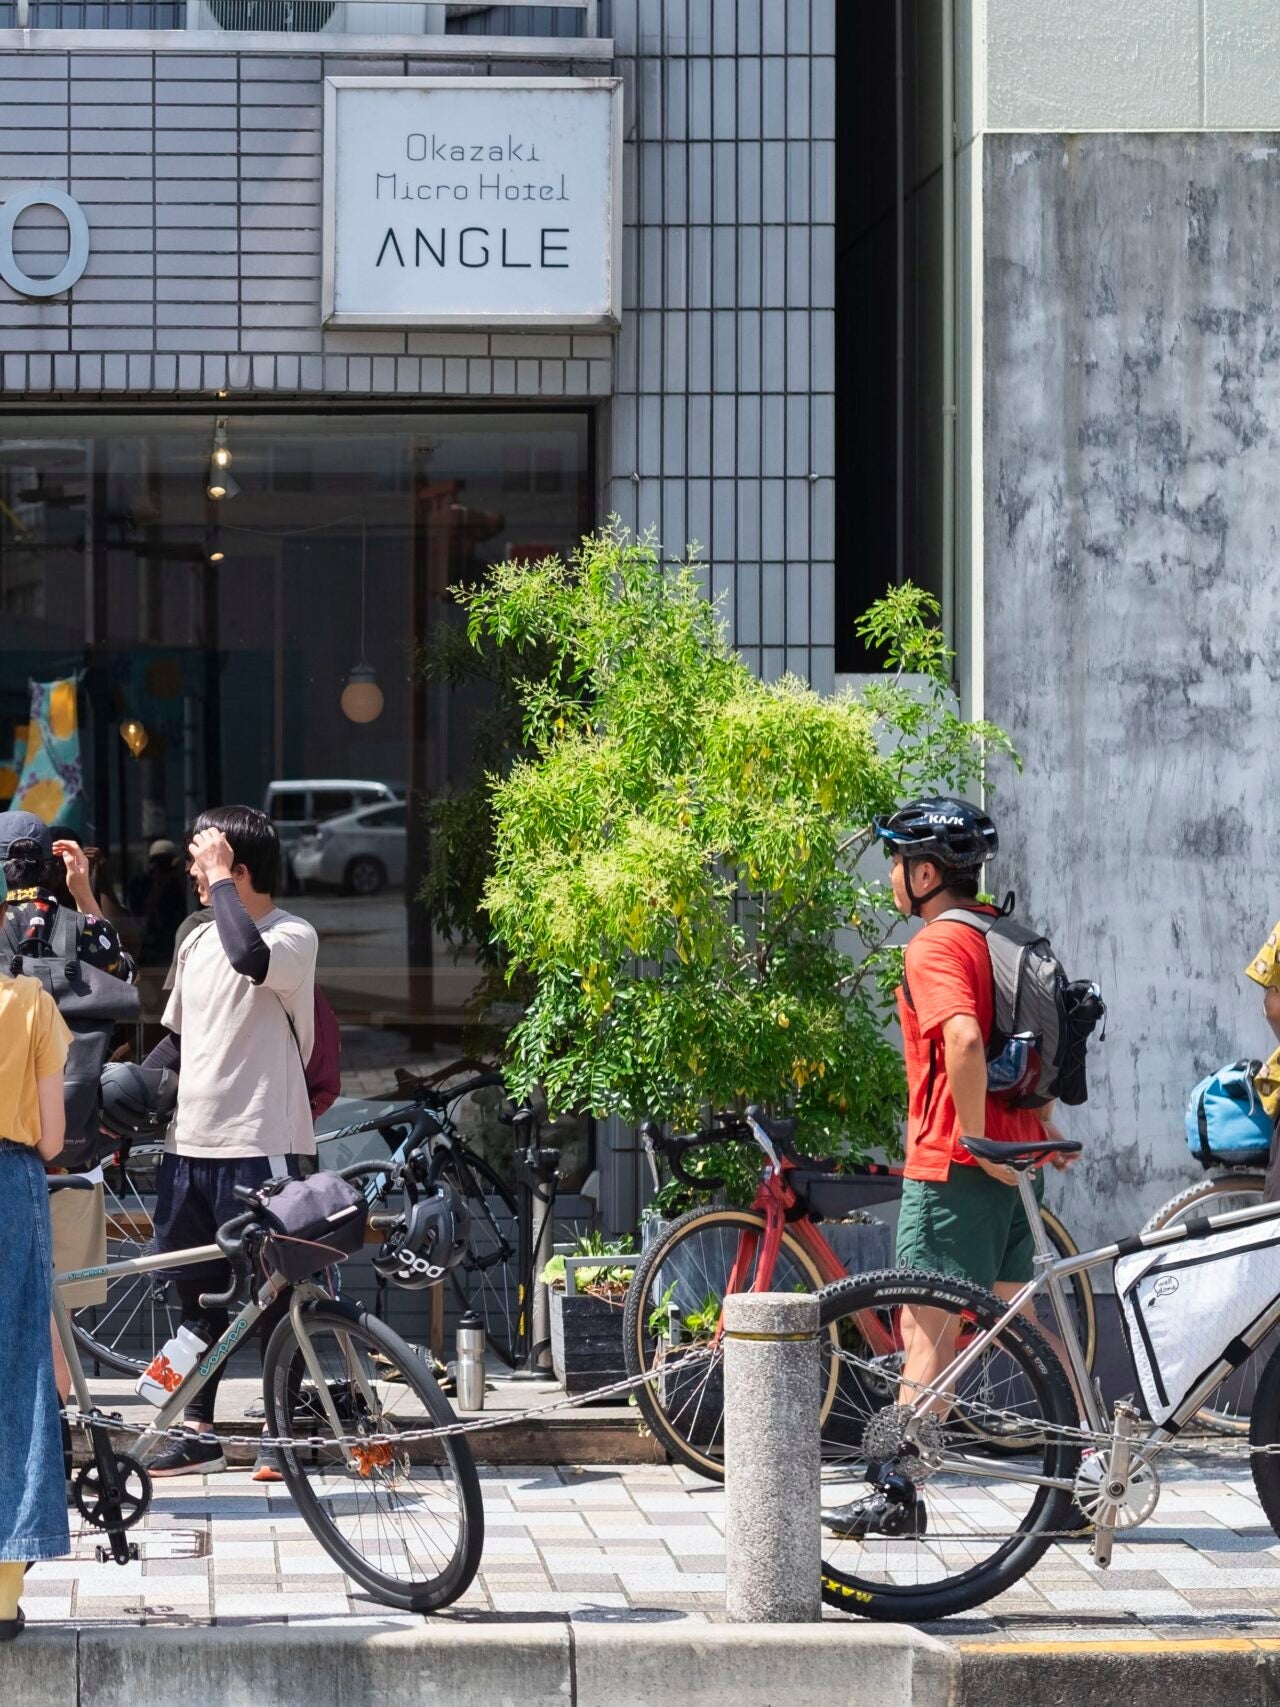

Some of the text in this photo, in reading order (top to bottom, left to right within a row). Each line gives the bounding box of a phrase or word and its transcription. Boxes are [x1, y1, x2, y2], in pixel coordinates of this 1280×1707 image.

[406, 133, 540, 162] Okazaki
[376, 172, 570, 201] Micro Hotel
[375, 227, 570, 268] ANGLE
[873, 1286, 931, 1298] ARDENT
